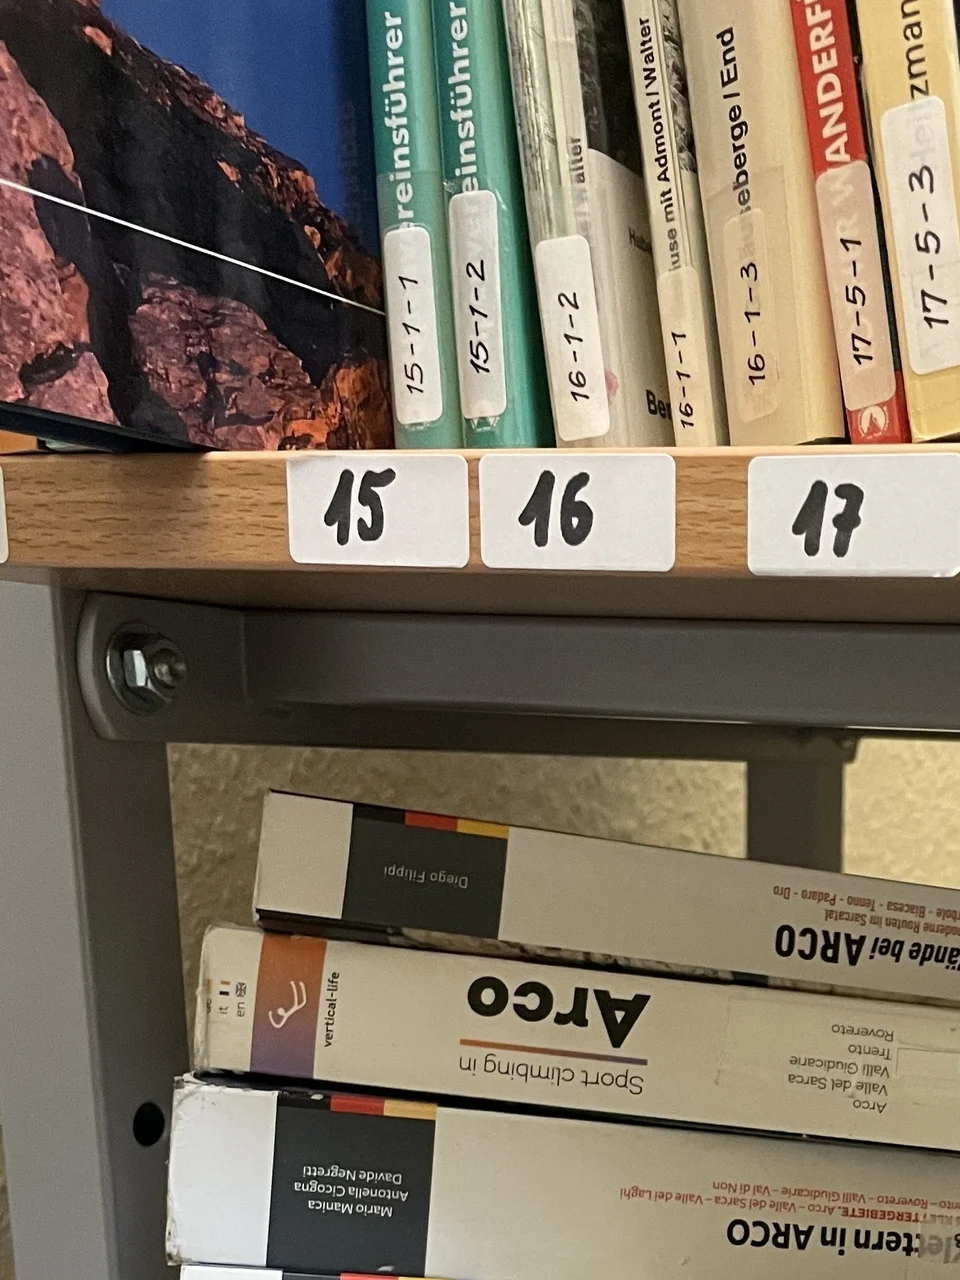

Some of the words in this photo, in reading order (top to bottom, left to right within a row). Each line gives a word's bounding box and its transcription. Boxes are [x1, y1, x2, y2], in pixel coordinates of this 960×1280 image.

[716, 27, 738, 87] End
[659, 189, 676, 221] mit
[908, 164, 950, 329] 17-5-3
[466, 259, 491, 374] 15-1-2
[840, 236, 874, 365] 17-5-1
[398, 275, 424, 394] 15-1-1
[740, 261, 766, 386] 16-1-3
[557, 291, 590, 402] 16-1-2
[671, 331, 695, 429] 16-1-1
[323, 468, 396, 546] 15
[517, 469, 594, 548] 16
[791, 479, 865, 558] 17
[383, 864, 426, 884] Filippi
[430, 870, 469, 890] Diego
[774, 924, 867, 966] ARCO
[869, 935, 904, 964] bei
[323, 971, 341, 1049] vertical-life
[467, 976, 651, 1049] Arco
[831, 1022, 895, 1043] Rovereto
[458, 1056, 477, 1076] in
[847, 1043, 892, 1060] Trento
[484, 1053, 576, 1085] climbing
[580, 1069, 644, 1096] Sport
[852, 1098, 887, 1115] Arco
[302, 1164, 357, 1181] Negretti
[360, 1168, 403, 1185] Davide
[294, 1179, 346, 1199] Cicogna
[348, 1185, 409, 1203] Antonella
[308, 1199, 354, 1215] Manica
[355, 1201, 394, 1218] Mario
